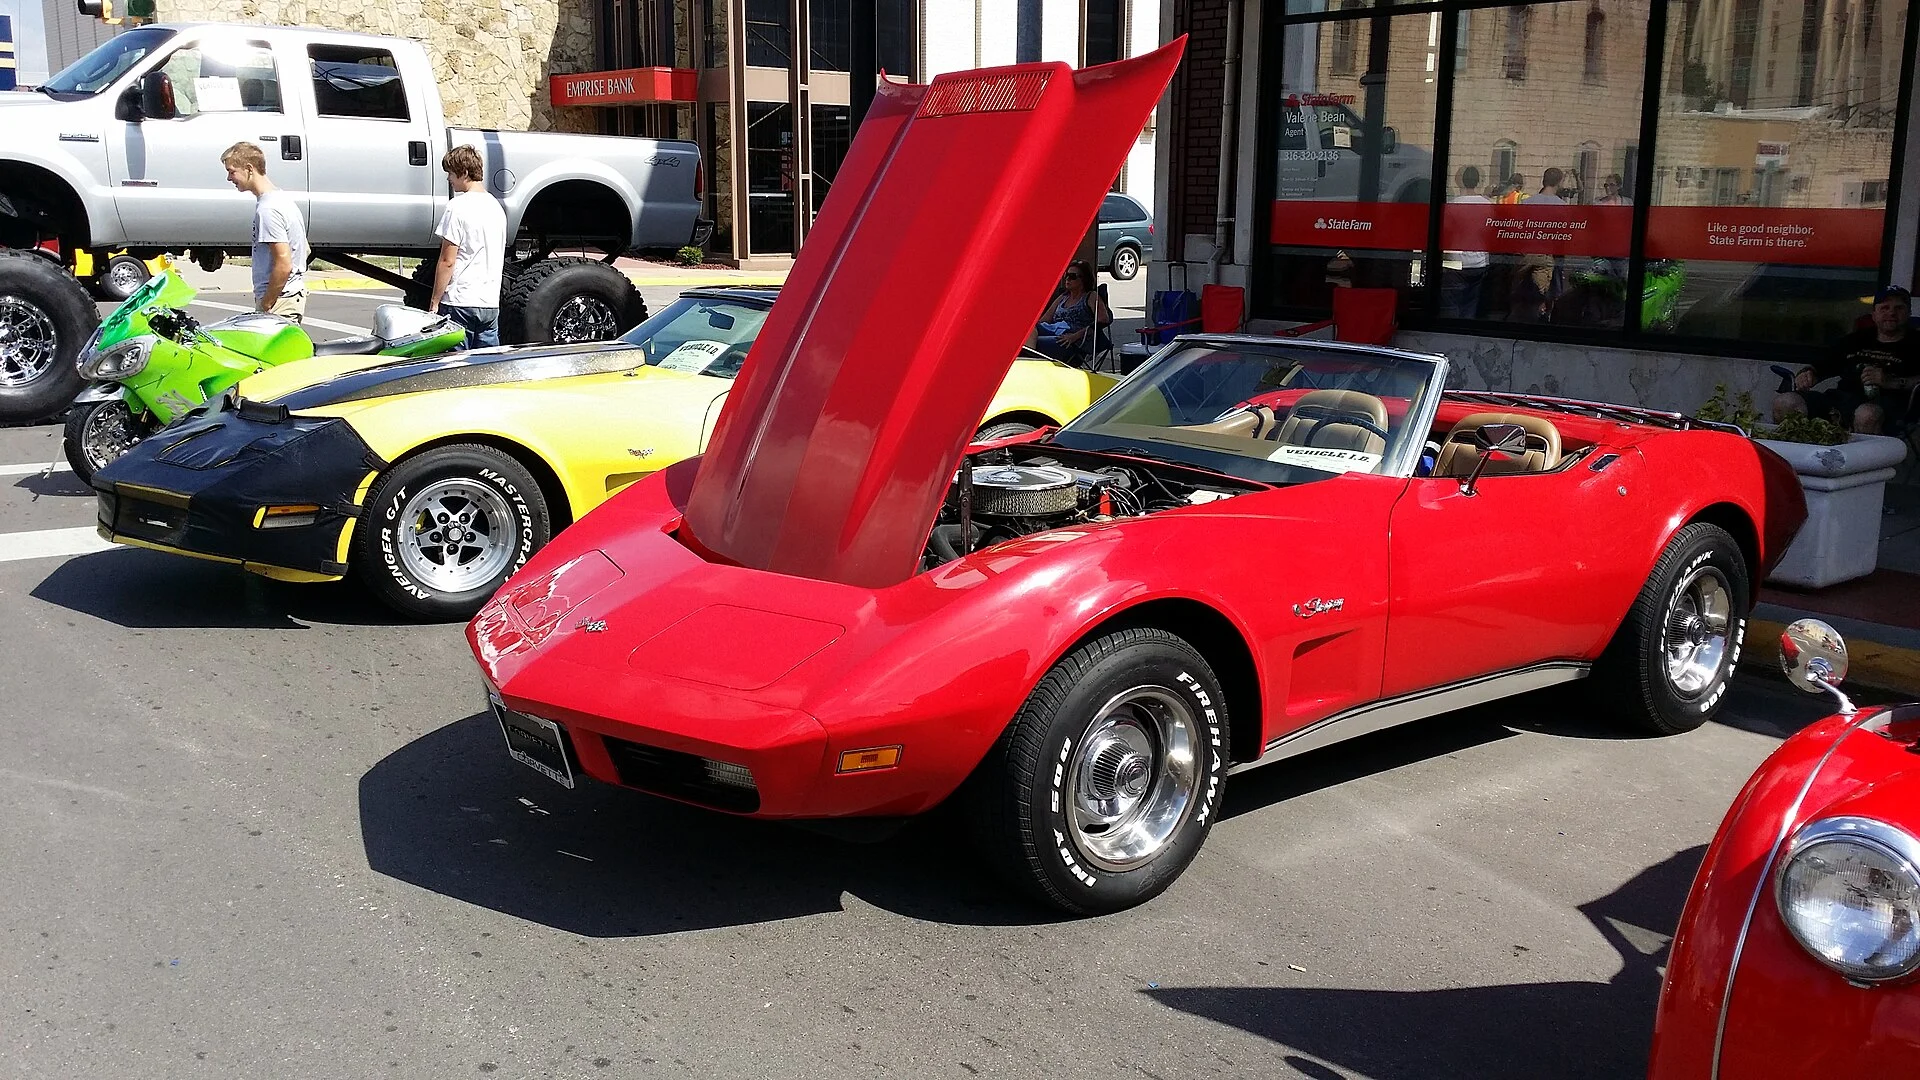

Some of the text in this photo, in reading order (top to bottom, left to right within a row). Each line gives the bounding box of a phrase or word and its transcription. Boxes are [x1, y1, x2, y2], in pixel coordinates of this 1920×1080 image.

[566, 77, 636, 98] EMPRISE BANK
[1321, 110, 1345, 122] Bean
[1285, 128, 1305, 138] Agent
[1284, 150, 1340, 161] 316-320-2136
[1485, 217, 1588, 230] Providing Insurance and
[1707, 222, 1815, 236] Like a good neighbor,
[1496, 229, 1573, 241] Financial Services
[1709, 234, 1807, 248] State Farm is there.
[1286, 449, 1347, 458] VEHICLE
[381, 485, 432, 600] AVENGER G/T
[1729, 618, 1746, 678] INDY
[1176, 671, 1222, 827] FIREHAWK
[1051, 736, 1098, 888] INDY 500
